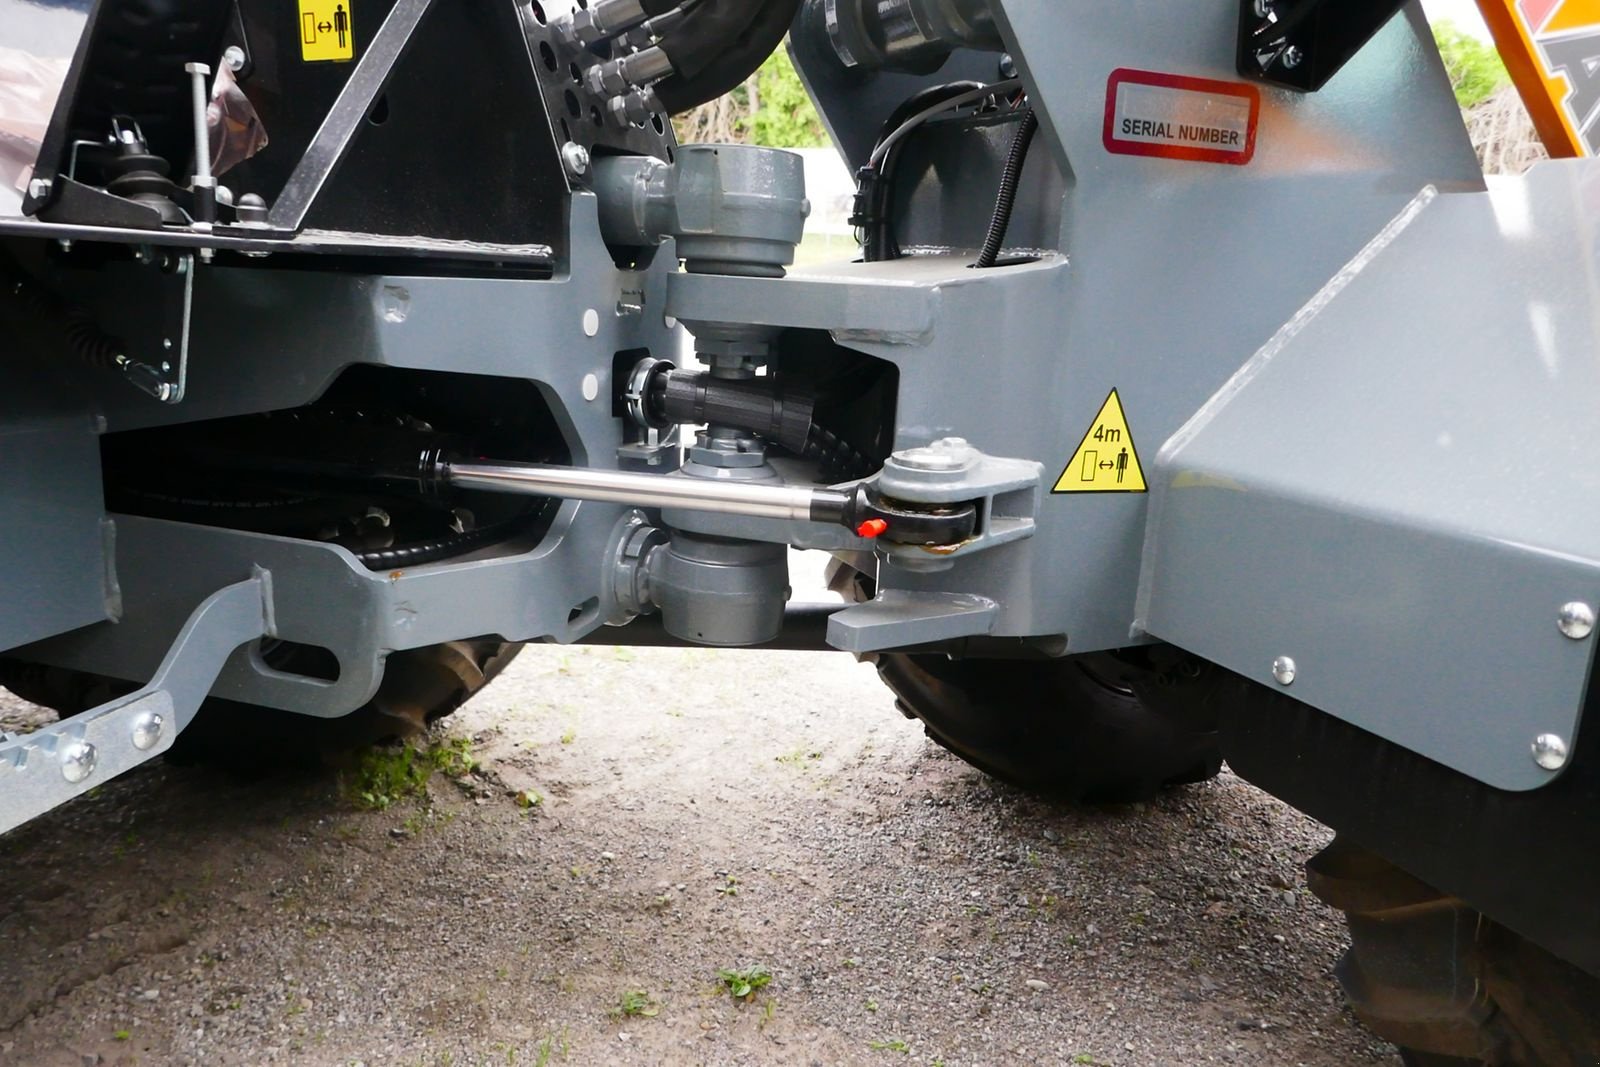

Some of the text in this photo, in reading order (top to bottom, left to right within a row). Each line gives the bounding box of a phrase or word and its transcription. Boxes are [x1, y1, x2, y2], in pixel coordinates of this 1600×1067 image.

[1122, 118, 1239, 145] SERIAL NUMBER
[1093, 424, 1120, 442] 4m
